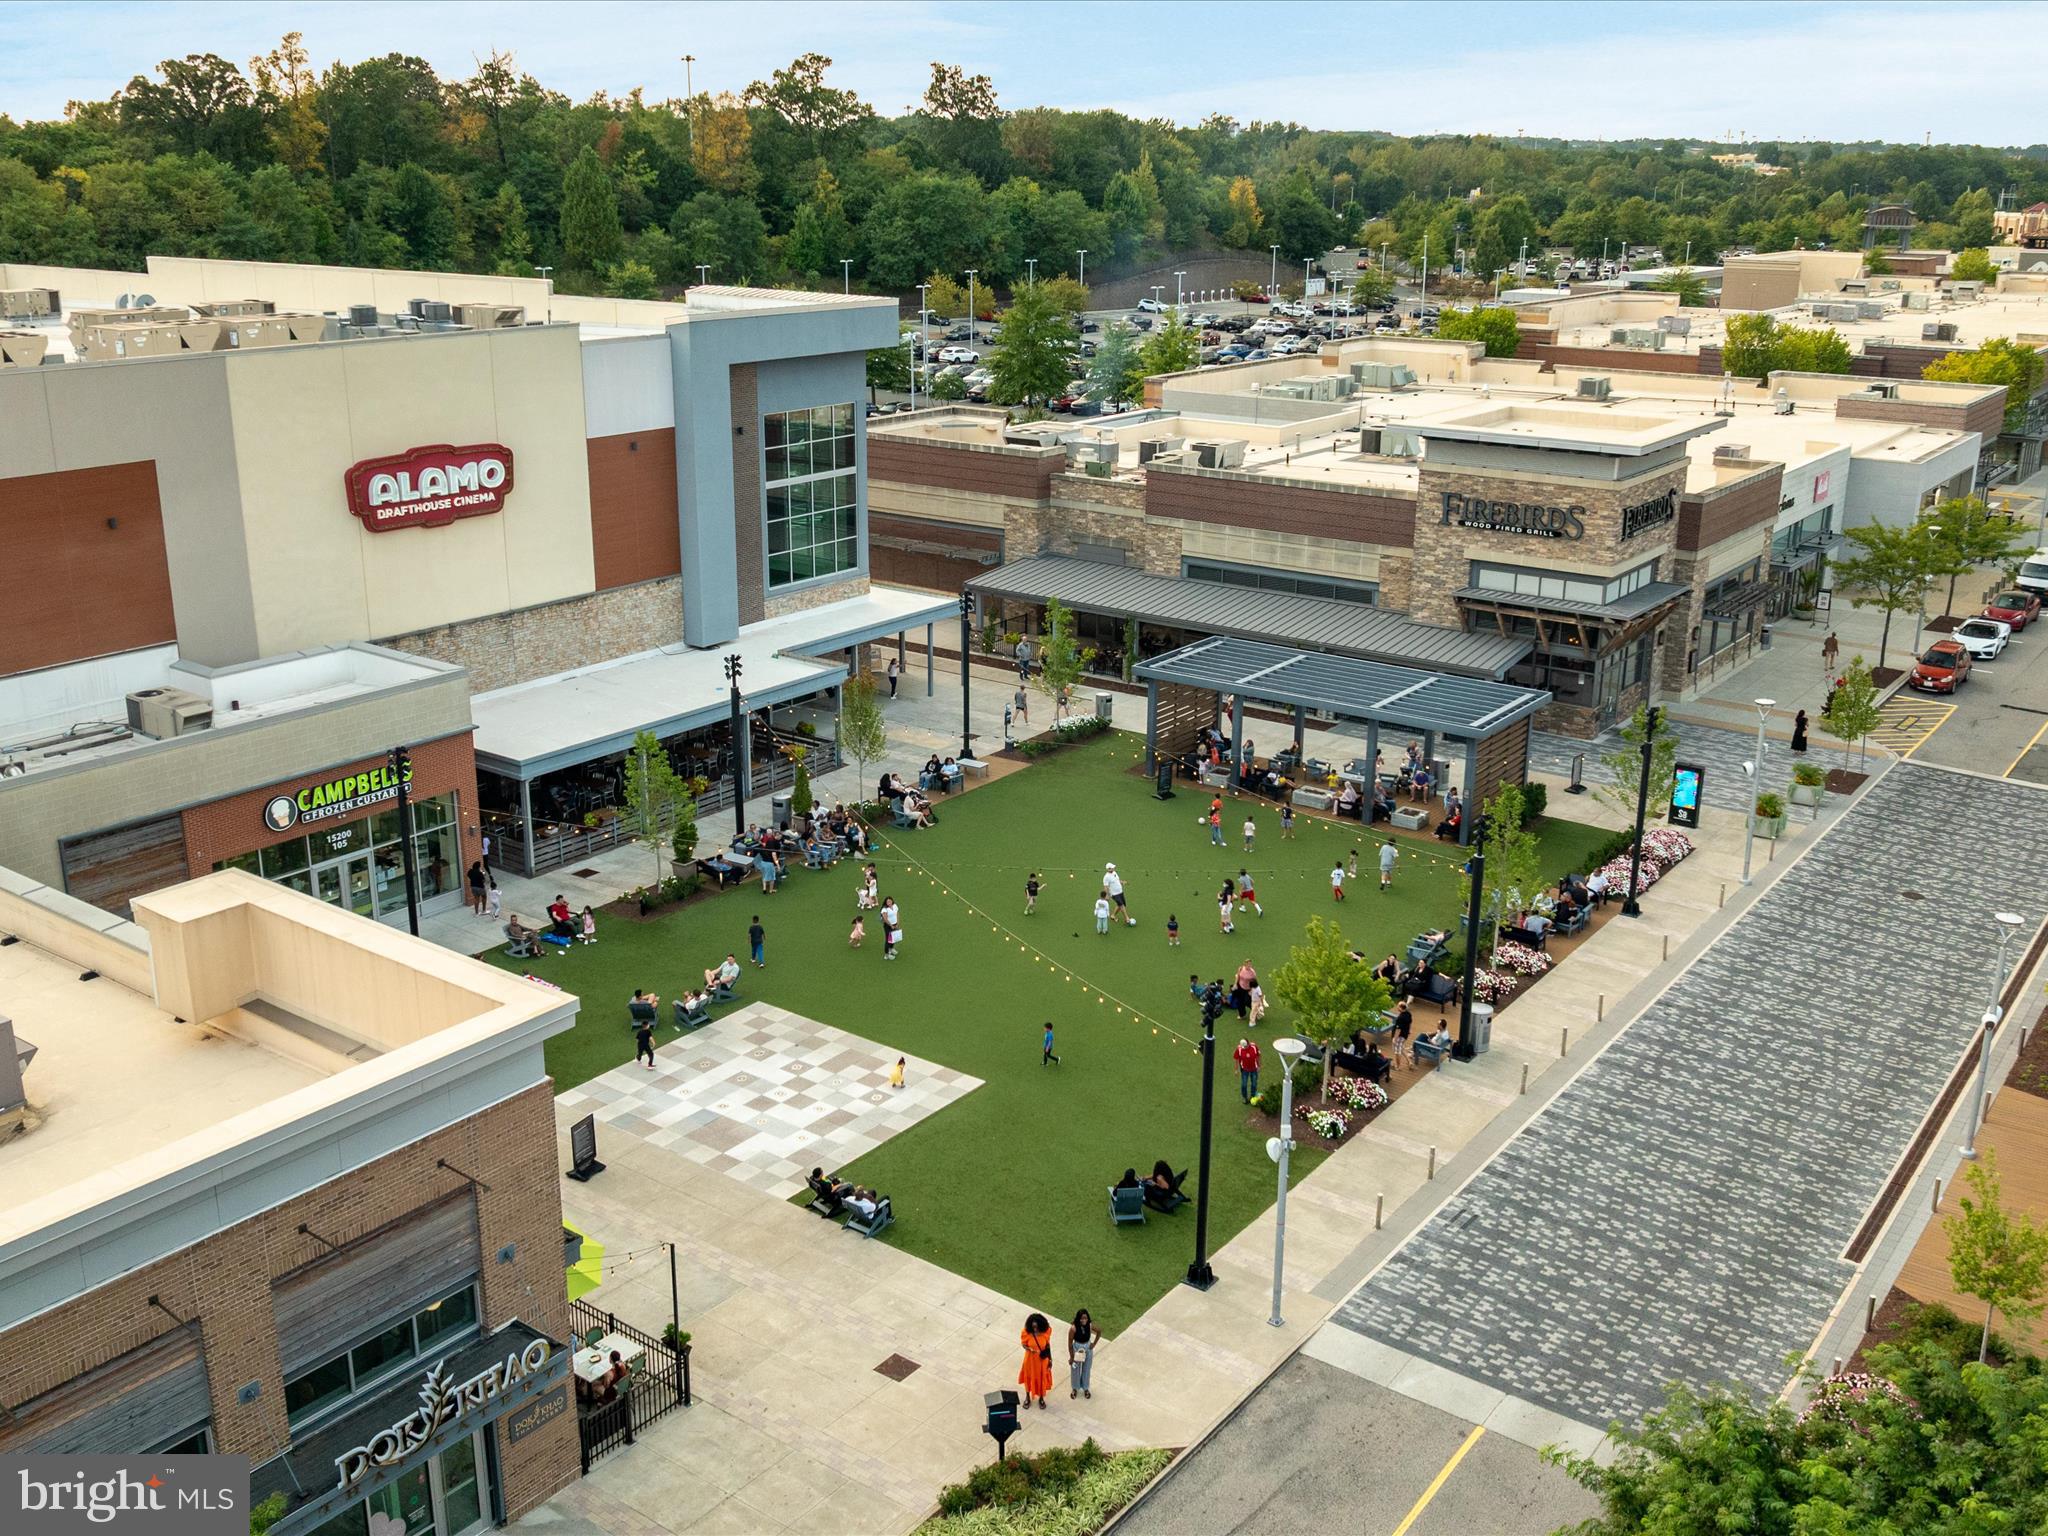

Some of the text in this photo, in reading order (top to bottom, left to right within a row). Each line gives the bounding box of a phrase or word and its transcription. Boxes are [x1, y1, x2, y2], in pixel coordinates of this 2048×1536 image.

[368, 458, 506, 507] ALAMO
[376, 492, 496, 520] DRAFTHOUSE CINEMA
[1439, 492, 1586, 540] FIREBIRDS
[1621, 487, 1677, 542] FIREBIRDS
[1464, 521, 1554, 537] WOOD FIRED GRILL
[312, 786, 399, 818] FROZEN CUSTAR
[326, 829, 352, 844] 15200
[332, 839, 348, 850] 105
[335, 1338, 551, 1490] DOK KHAO
[541, 1396, 564, 1416] KHAO
